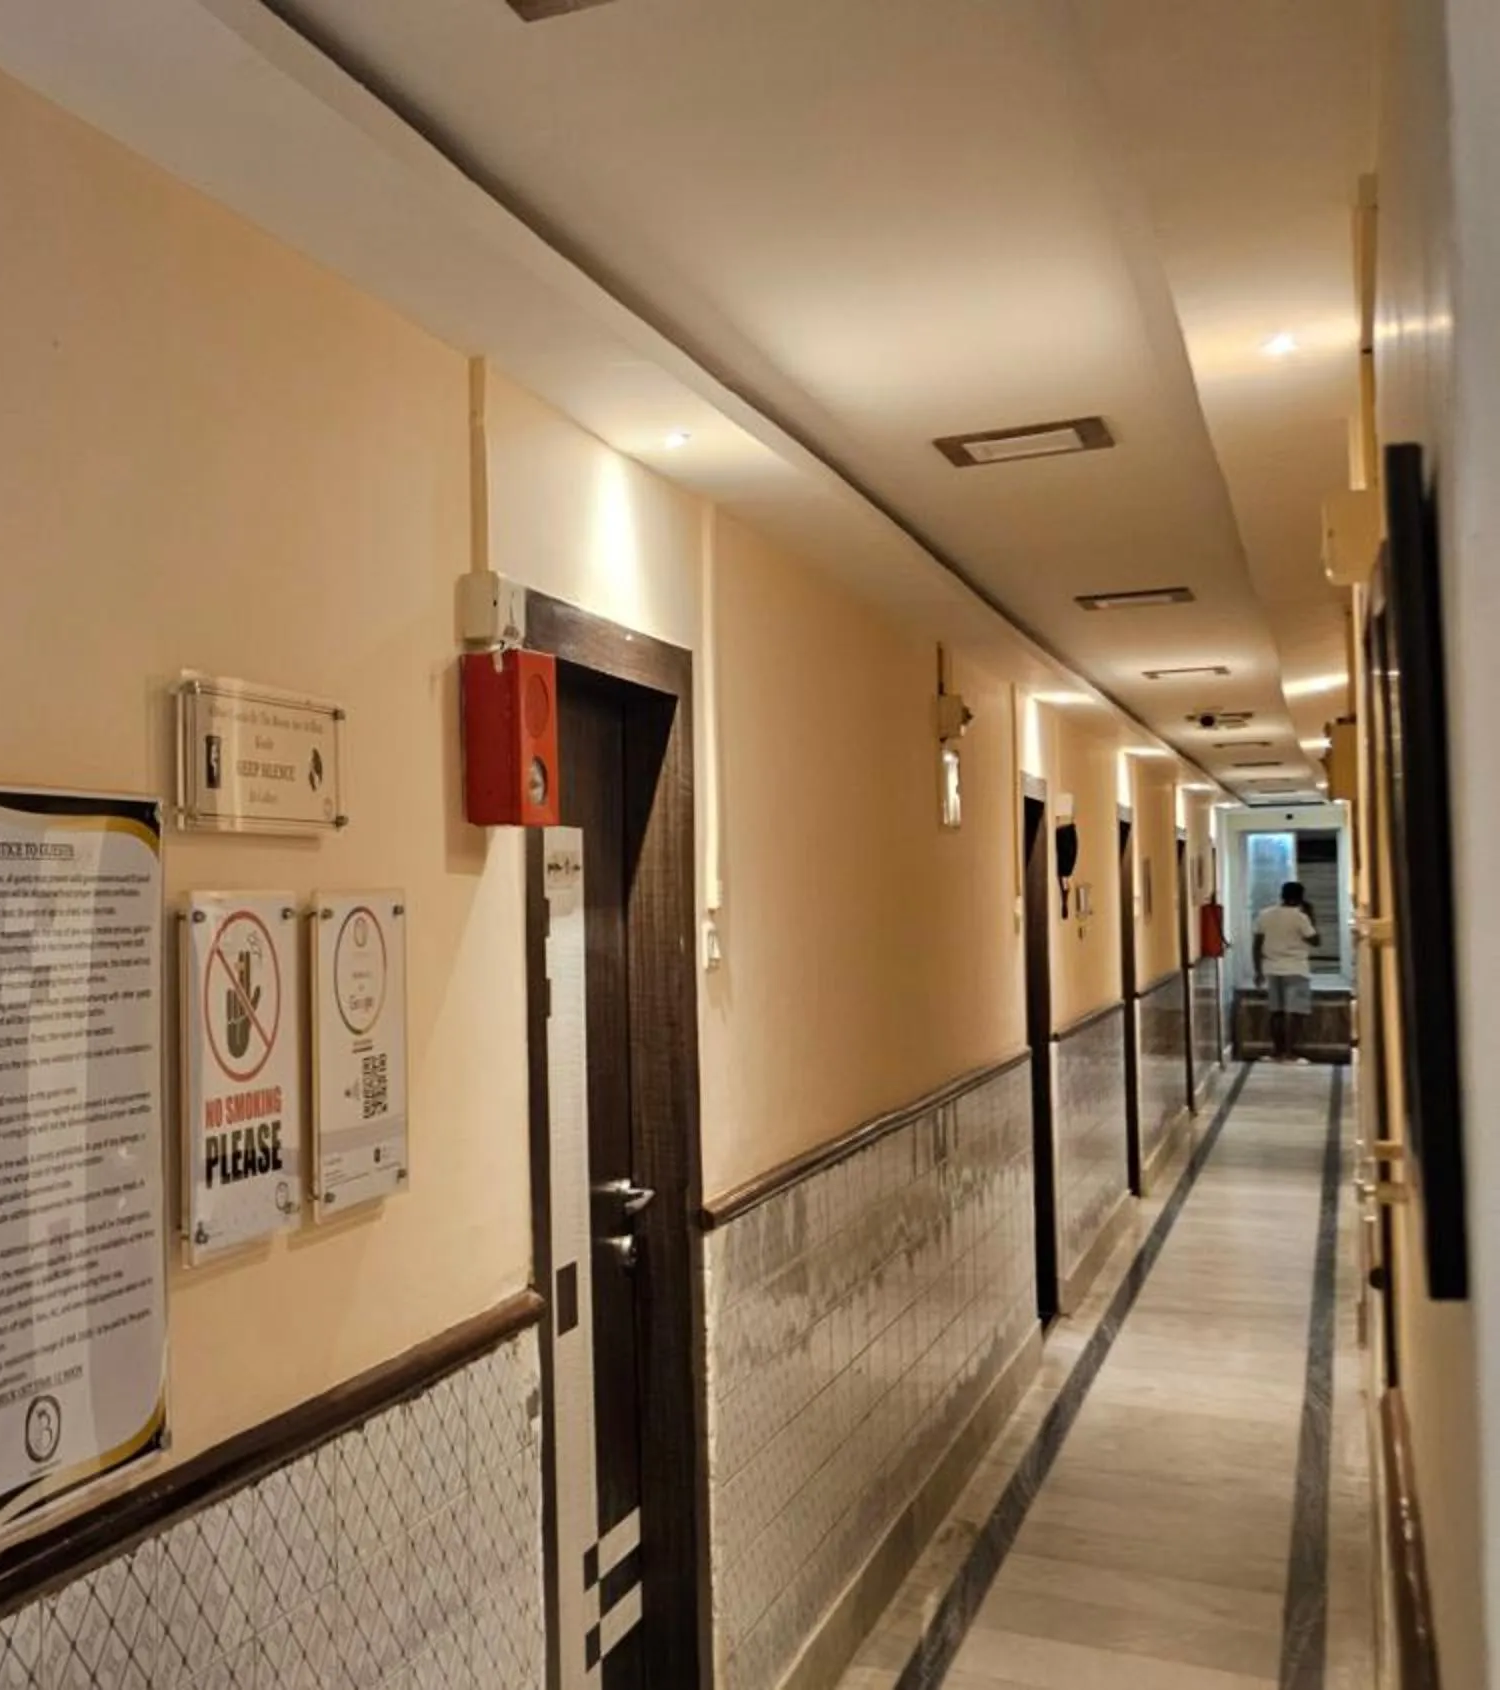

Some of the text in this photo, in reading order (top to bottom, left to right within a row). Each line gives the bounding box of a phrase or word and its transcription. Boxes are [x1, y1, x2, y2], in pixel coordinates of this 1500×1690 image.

[205, 1084, 282, 1128] NO SMOKING
[205, 1119, 283, 1190] PLEASE
